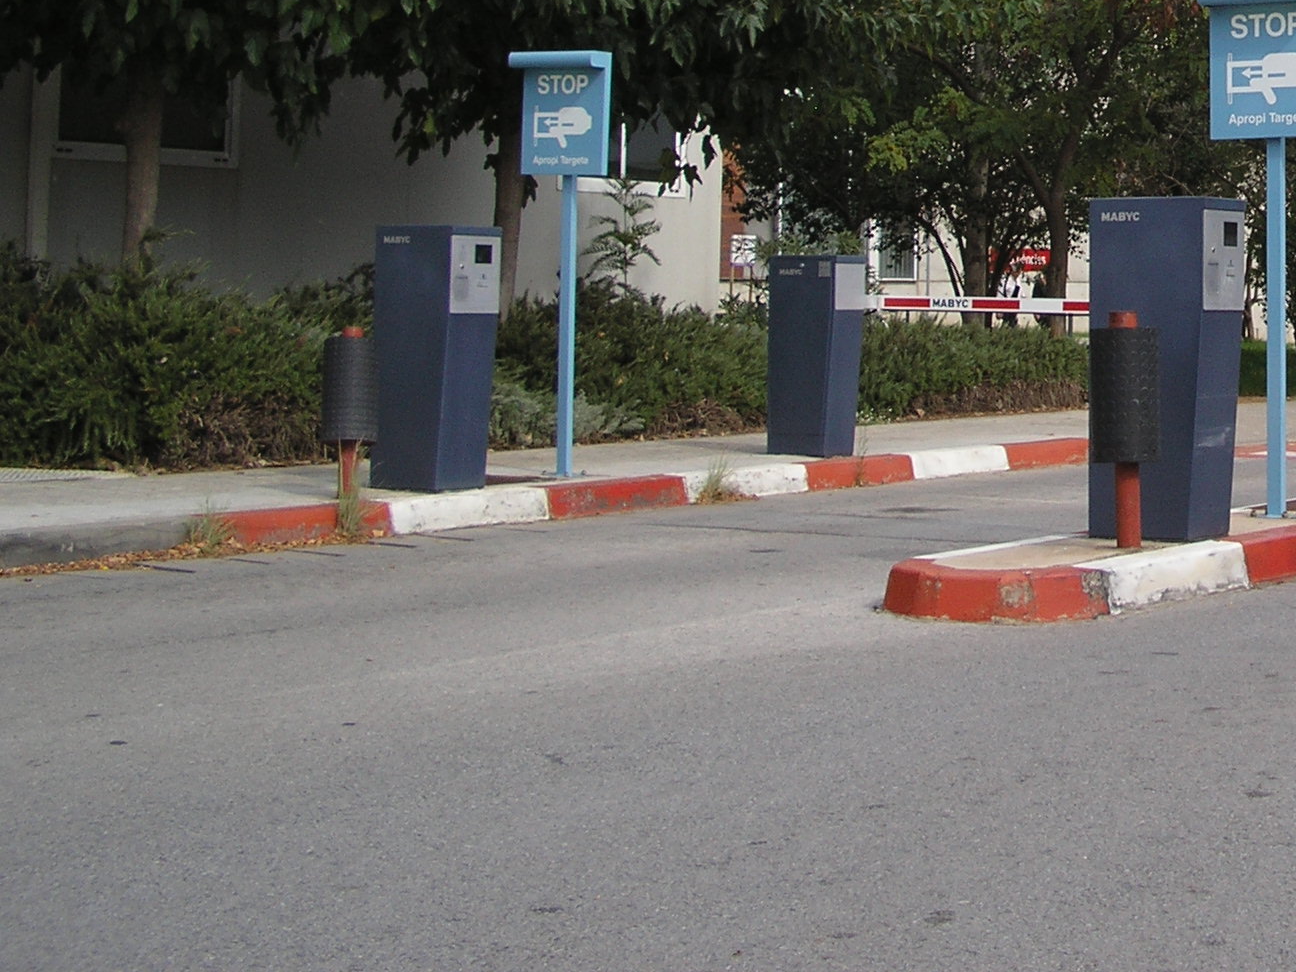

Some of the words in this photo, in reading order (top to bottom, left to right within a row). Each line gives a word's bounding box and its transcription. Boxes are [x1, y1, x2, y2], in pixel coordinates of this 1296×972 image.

[537, 74, 589, 95] STOP
[1229, 114, 1266, 127] Apropi
[533, 156, 559, 165] Apropi
[560, 155, 589, 166] Targeta
[1101, 212, 1140, 222] MABYC
[383, 236, 411, 244] MABYC
[932, 298, 969, 308] MABYC
